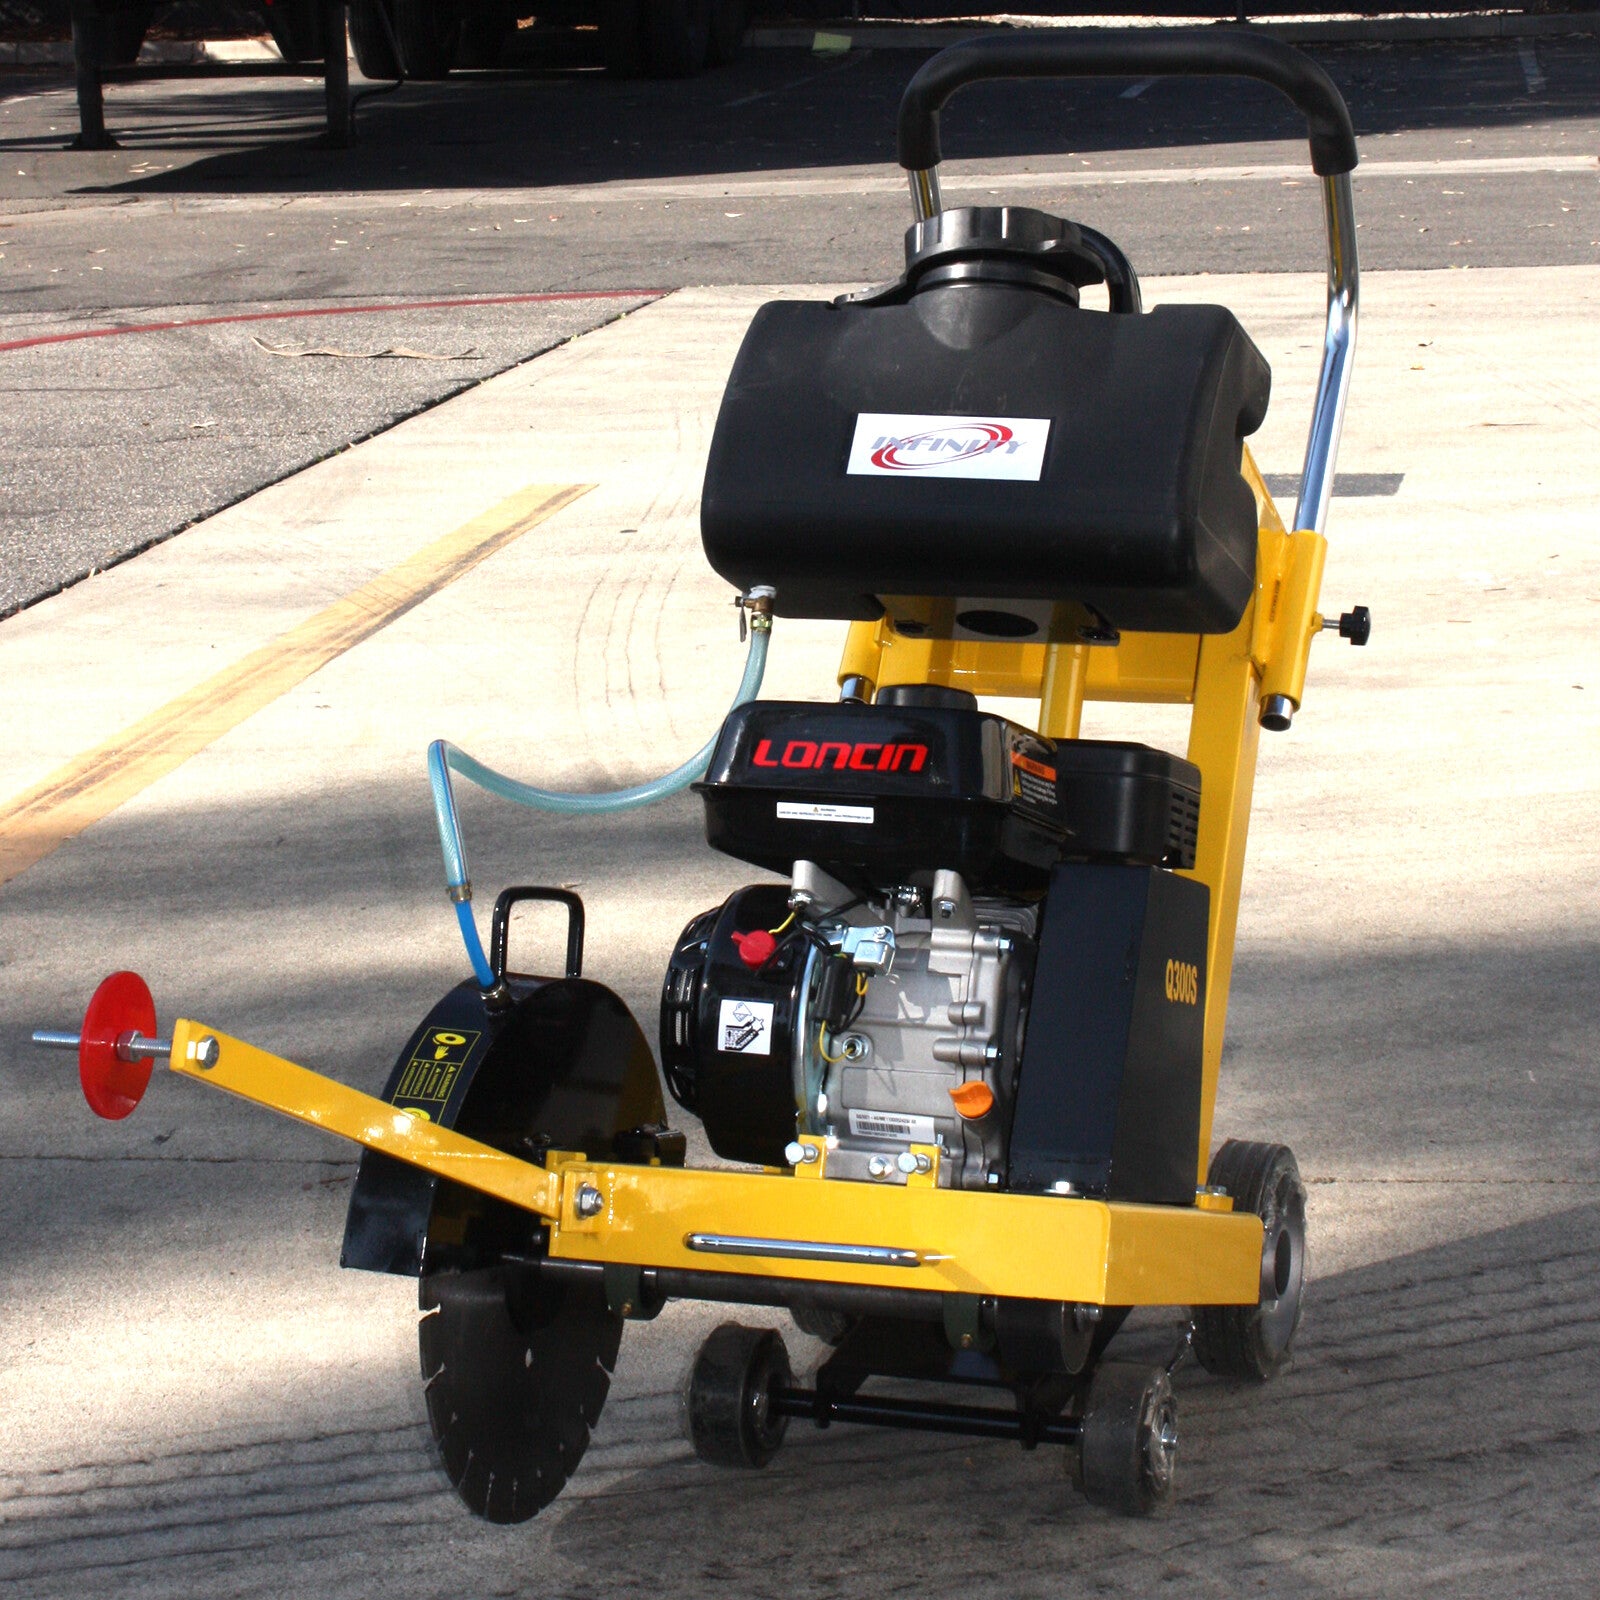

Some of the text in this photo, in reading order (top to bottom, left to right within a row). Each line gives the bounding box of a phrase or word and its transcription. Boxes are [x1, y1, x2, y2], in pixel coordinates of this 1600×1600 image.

[871, 436, 1026, 455] INFINITY
[752, 738, 928, 772] LONCIN
[1165, 959, 1198, 1006] Q300S
